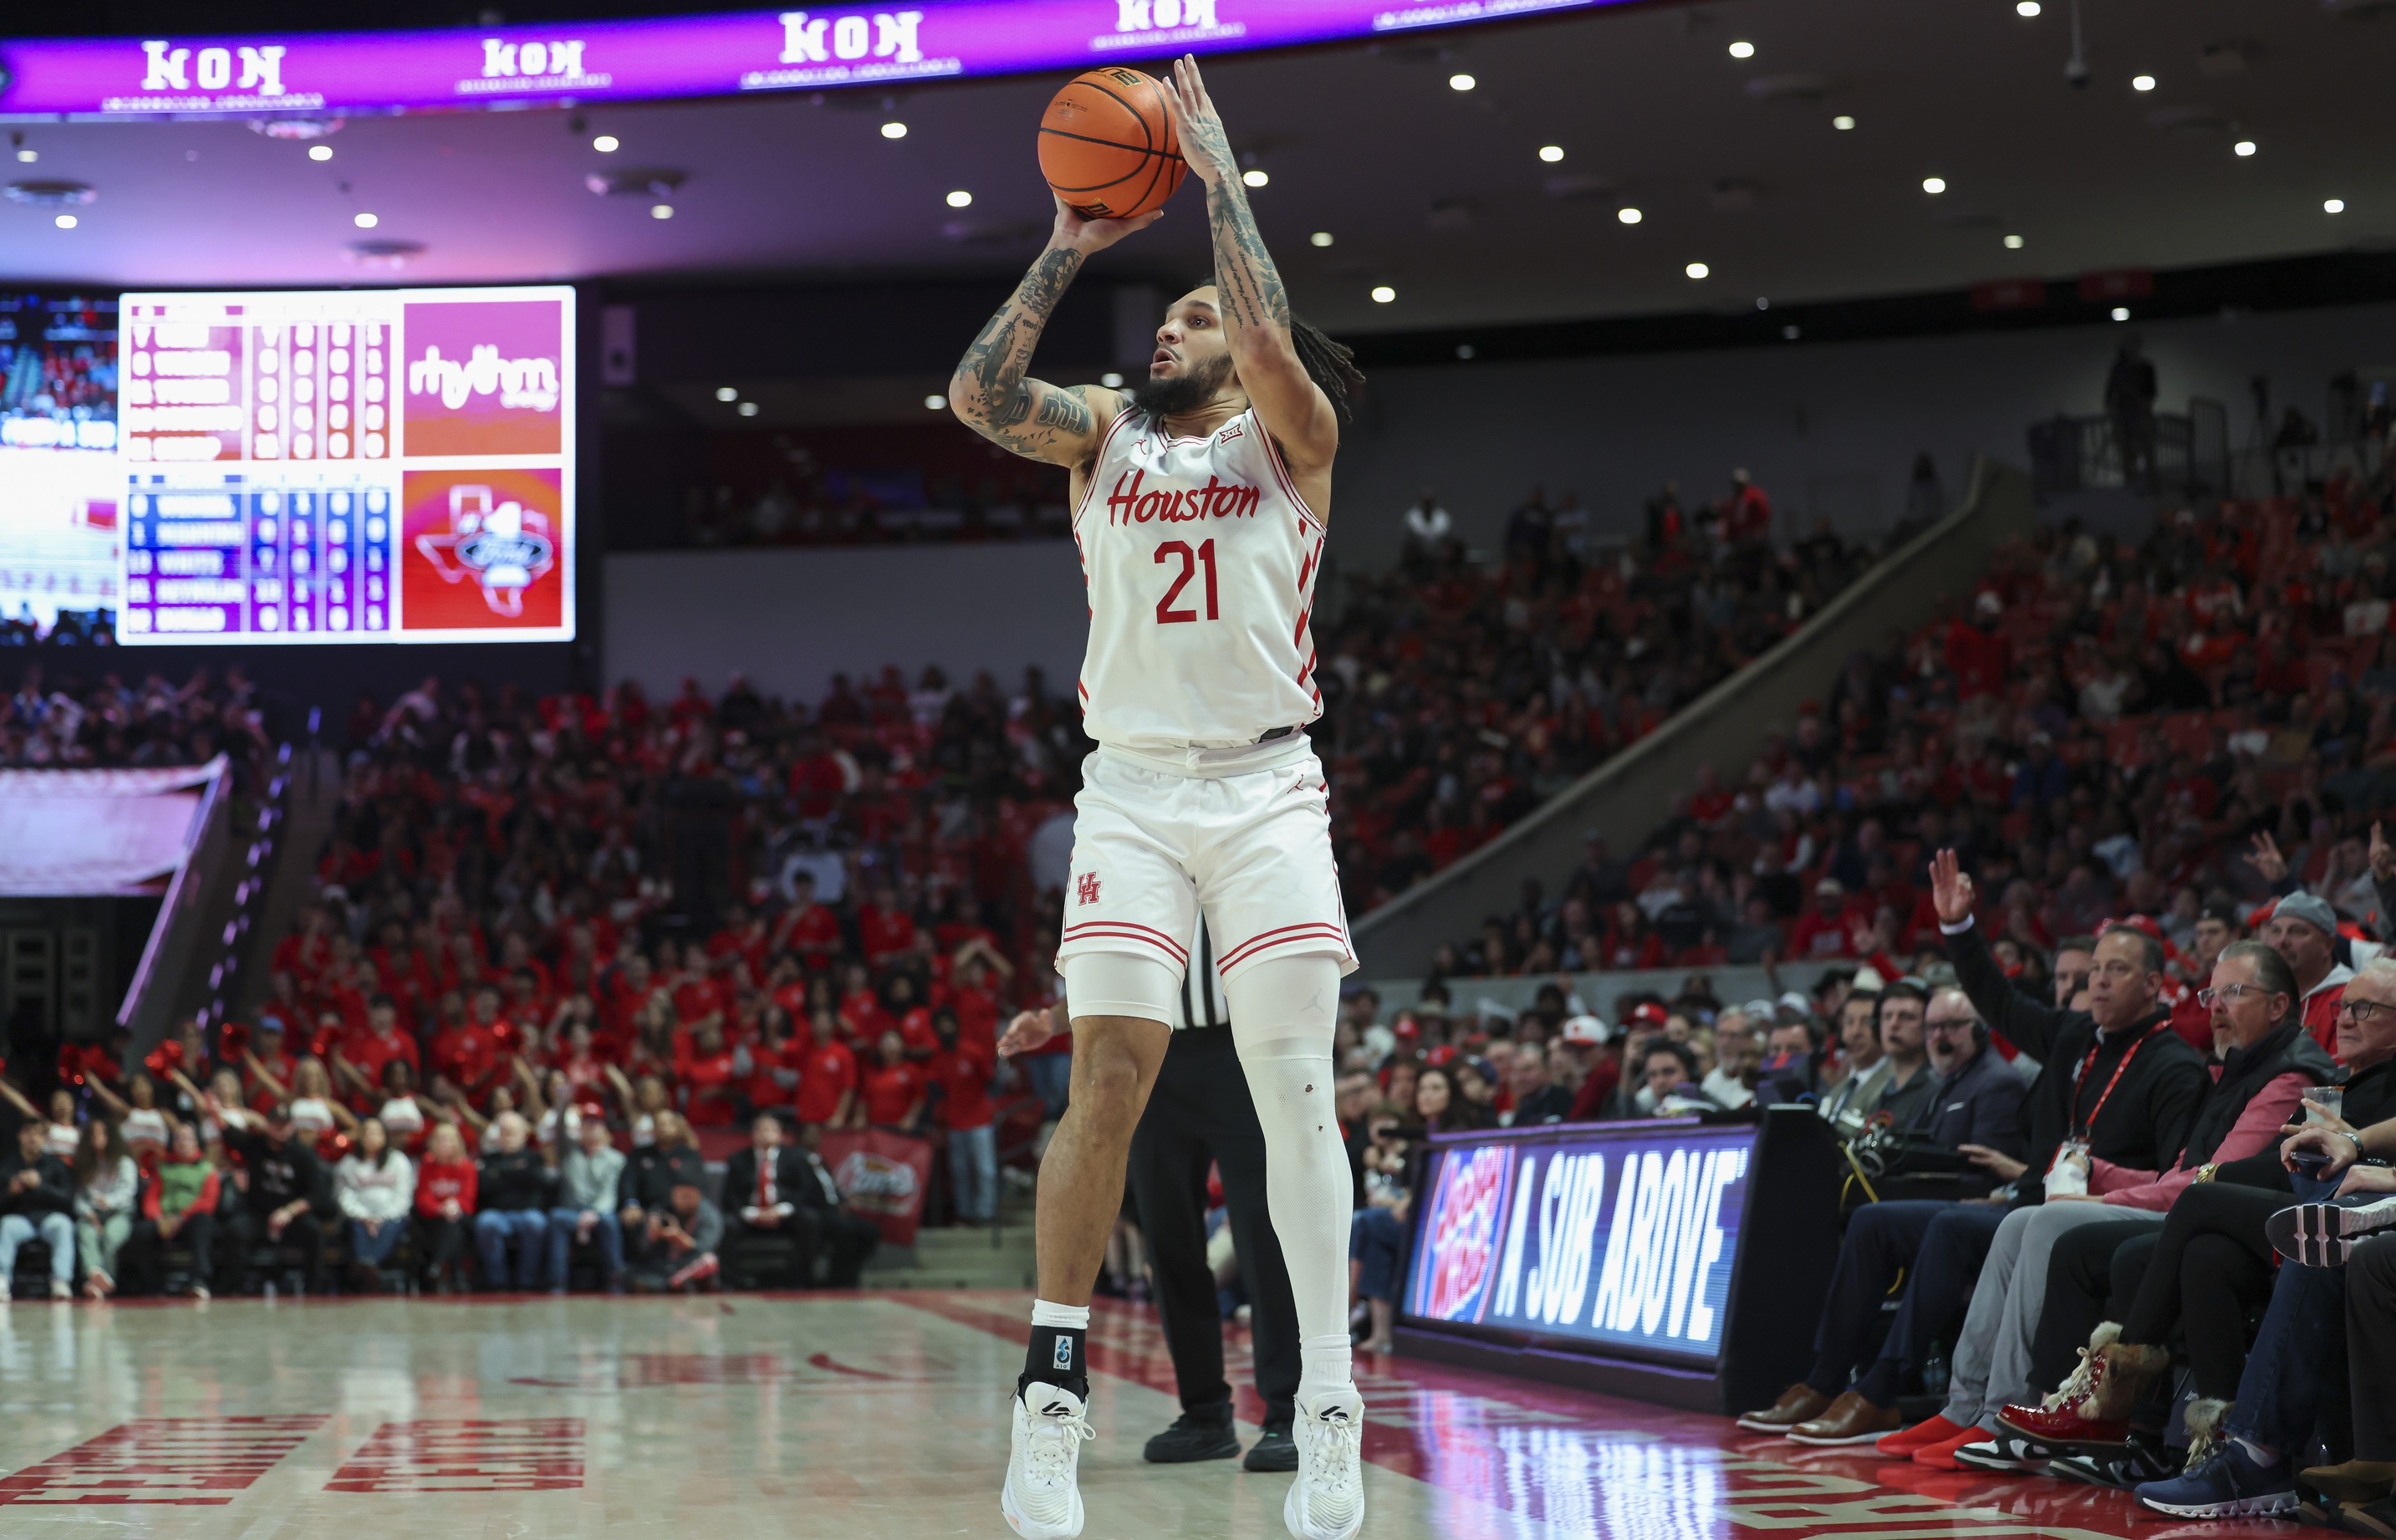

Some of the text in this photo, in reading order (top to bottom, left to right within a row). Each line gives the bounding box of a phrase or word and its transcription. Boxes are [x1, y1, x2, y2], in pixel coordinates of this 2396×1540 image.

[1107, 468, 1260, 527] Houston
[1154, 538, 1219, 624] 21
[1494, 1156, 1536, 1317] A
[1526, 1150, 1605, 1324] SUB
